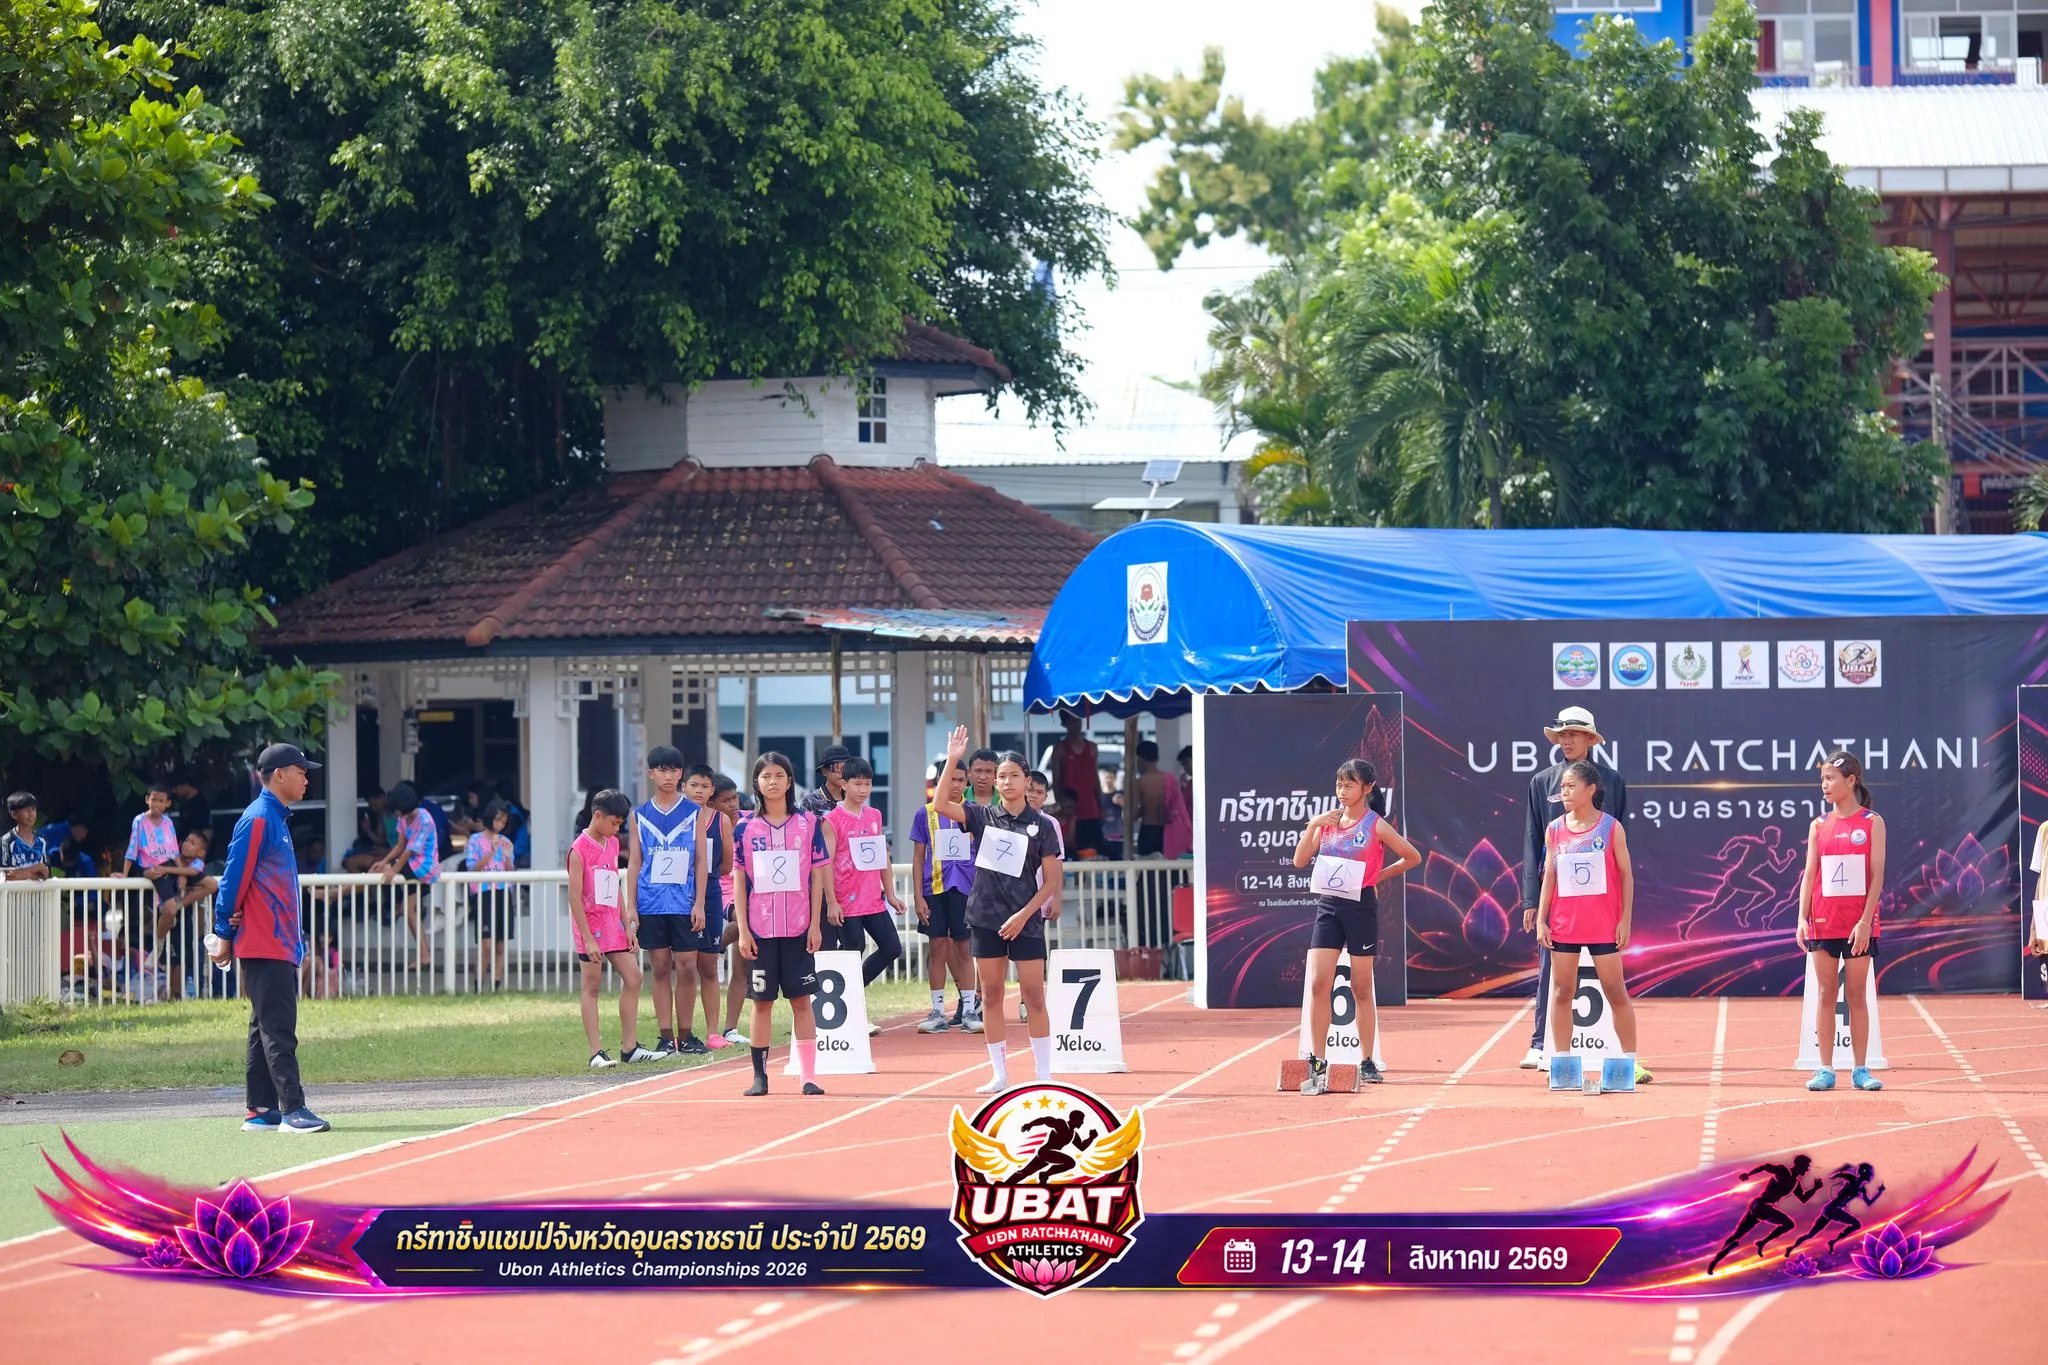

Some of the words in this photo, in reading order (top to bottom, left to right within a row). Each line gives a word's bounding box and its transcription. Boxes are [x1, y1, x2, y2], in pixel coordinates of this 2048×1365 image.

[1841, 664, 1874, 674] UBAT
[860, 842, 876, 864] 5
[949, 835, 960, 855] 6
[996, 839, 1014, 861] 7
[660, 857, 673, 876] 2
[772, 856, 787, 884] 8
[1328, 864, 1344, 889] 6
[1572, 862, 1592, 886] 5
[1831, 861, 1849, 887] 4
[603, 875, 613, 900] 1
[1287, 874, 1311, 888] สิงห
[752, 969, 767, 993] 5
[813, 969, 847, 1030] 8
[1062, 969, 1101, 1030] 7
[1330, 965, 1357, 1026] 6
[1572, 966, 1604, 1027] 5
[816, 1035, 850, 1052] elco
[1057, 1035, 1102, 1052] Nelco
[1326, 1032, 1360, 1048] elco
[1571, 1033, 1605, 1049] elco
